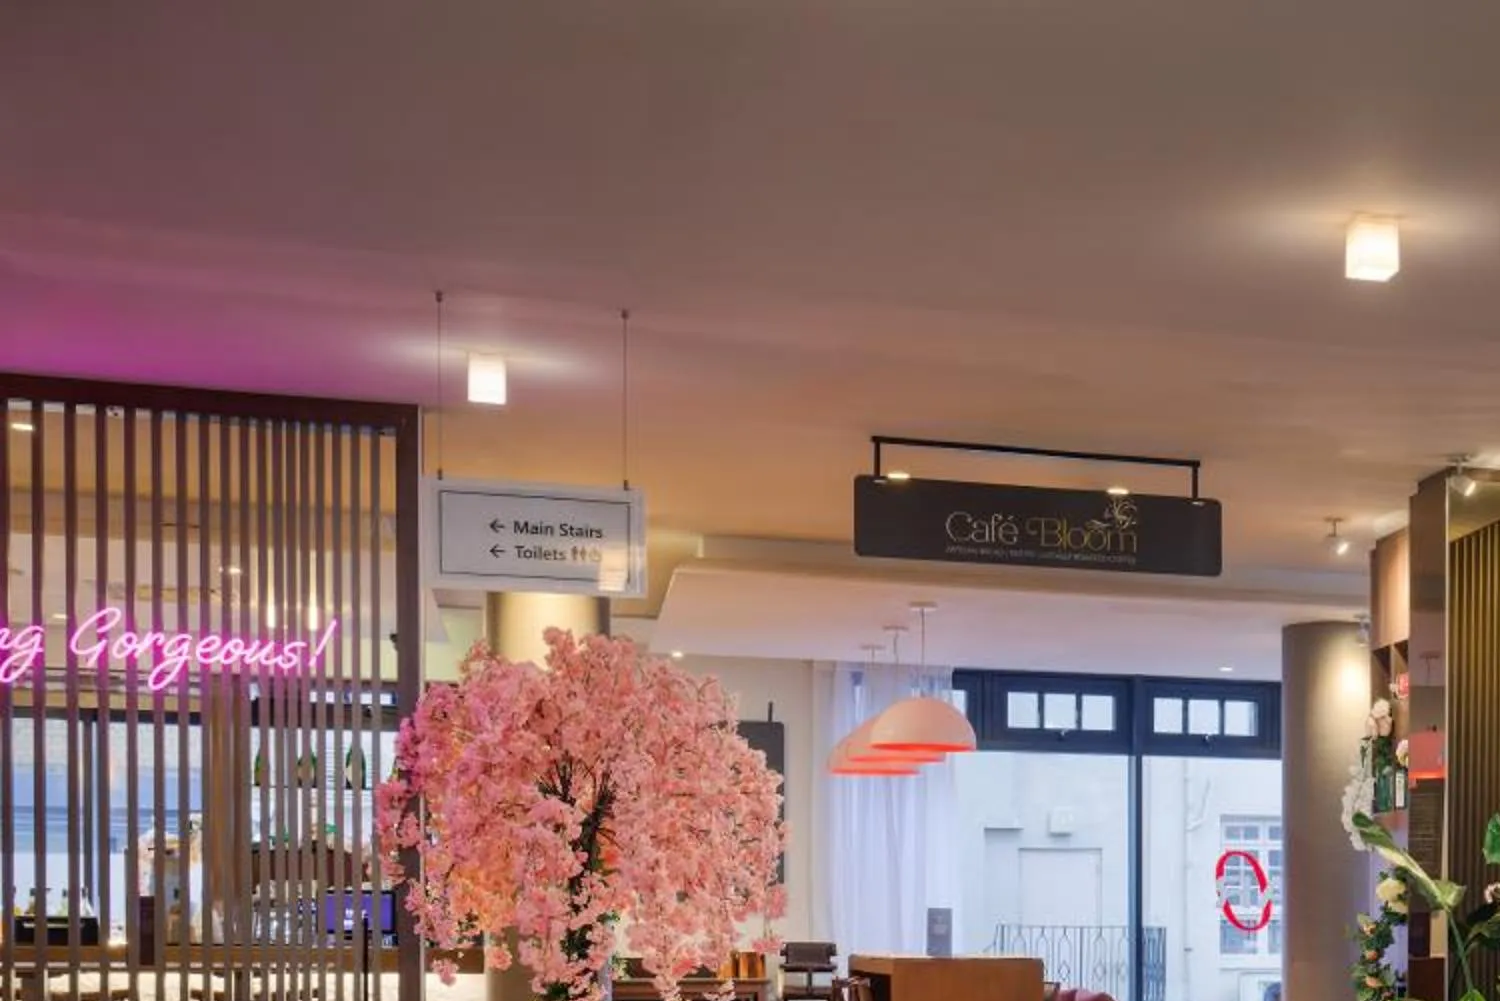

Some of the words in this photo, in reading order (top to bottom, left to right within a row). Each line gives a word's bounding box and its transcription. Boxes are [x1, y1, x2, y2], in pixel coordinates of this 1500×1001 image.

[513, 520, 554, 538] Main
[559, 523, 603, 539] Stairs
[945, 511, 1019, 545] Café
[1026, 517, 1138, 553] Bloom
[514, 545, 566, 562] Toilets
[69, 607, 337, 691] Gorgeous!
